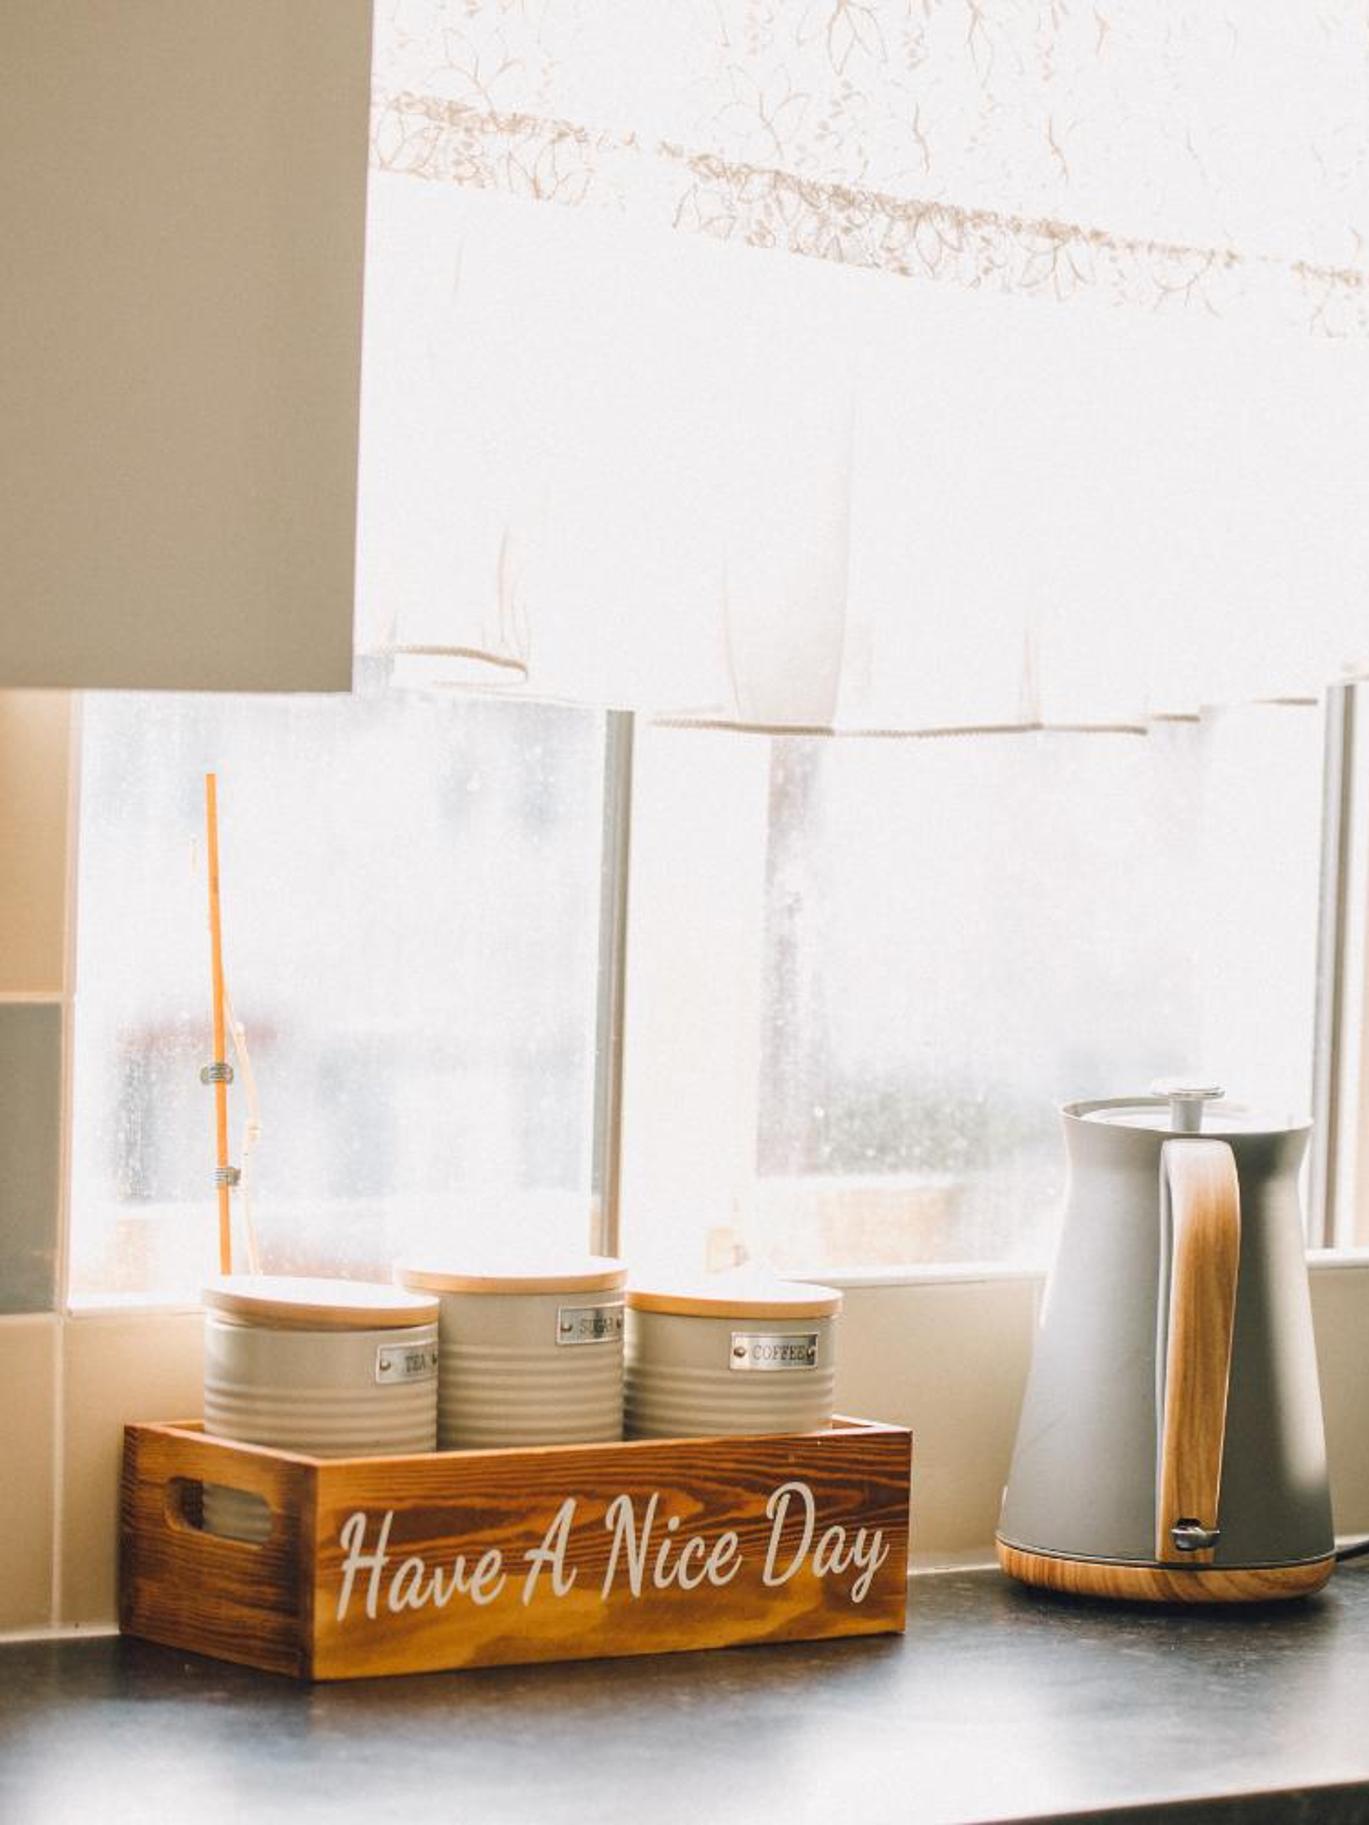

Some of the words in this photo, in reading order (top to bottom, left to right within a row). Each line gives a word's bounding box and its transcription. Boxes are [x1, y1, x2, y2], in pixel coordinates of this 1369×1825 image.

[752, 1344, 806, 1361] COFFEE
[405, 1353, 427, 1373] TEA
[337, 1511, 506, 1621] Have
[522, 1497, 578, 1606] A
[602, 1492, 742, 1600] Nice
[761, 1480, 890, 1603] Day
